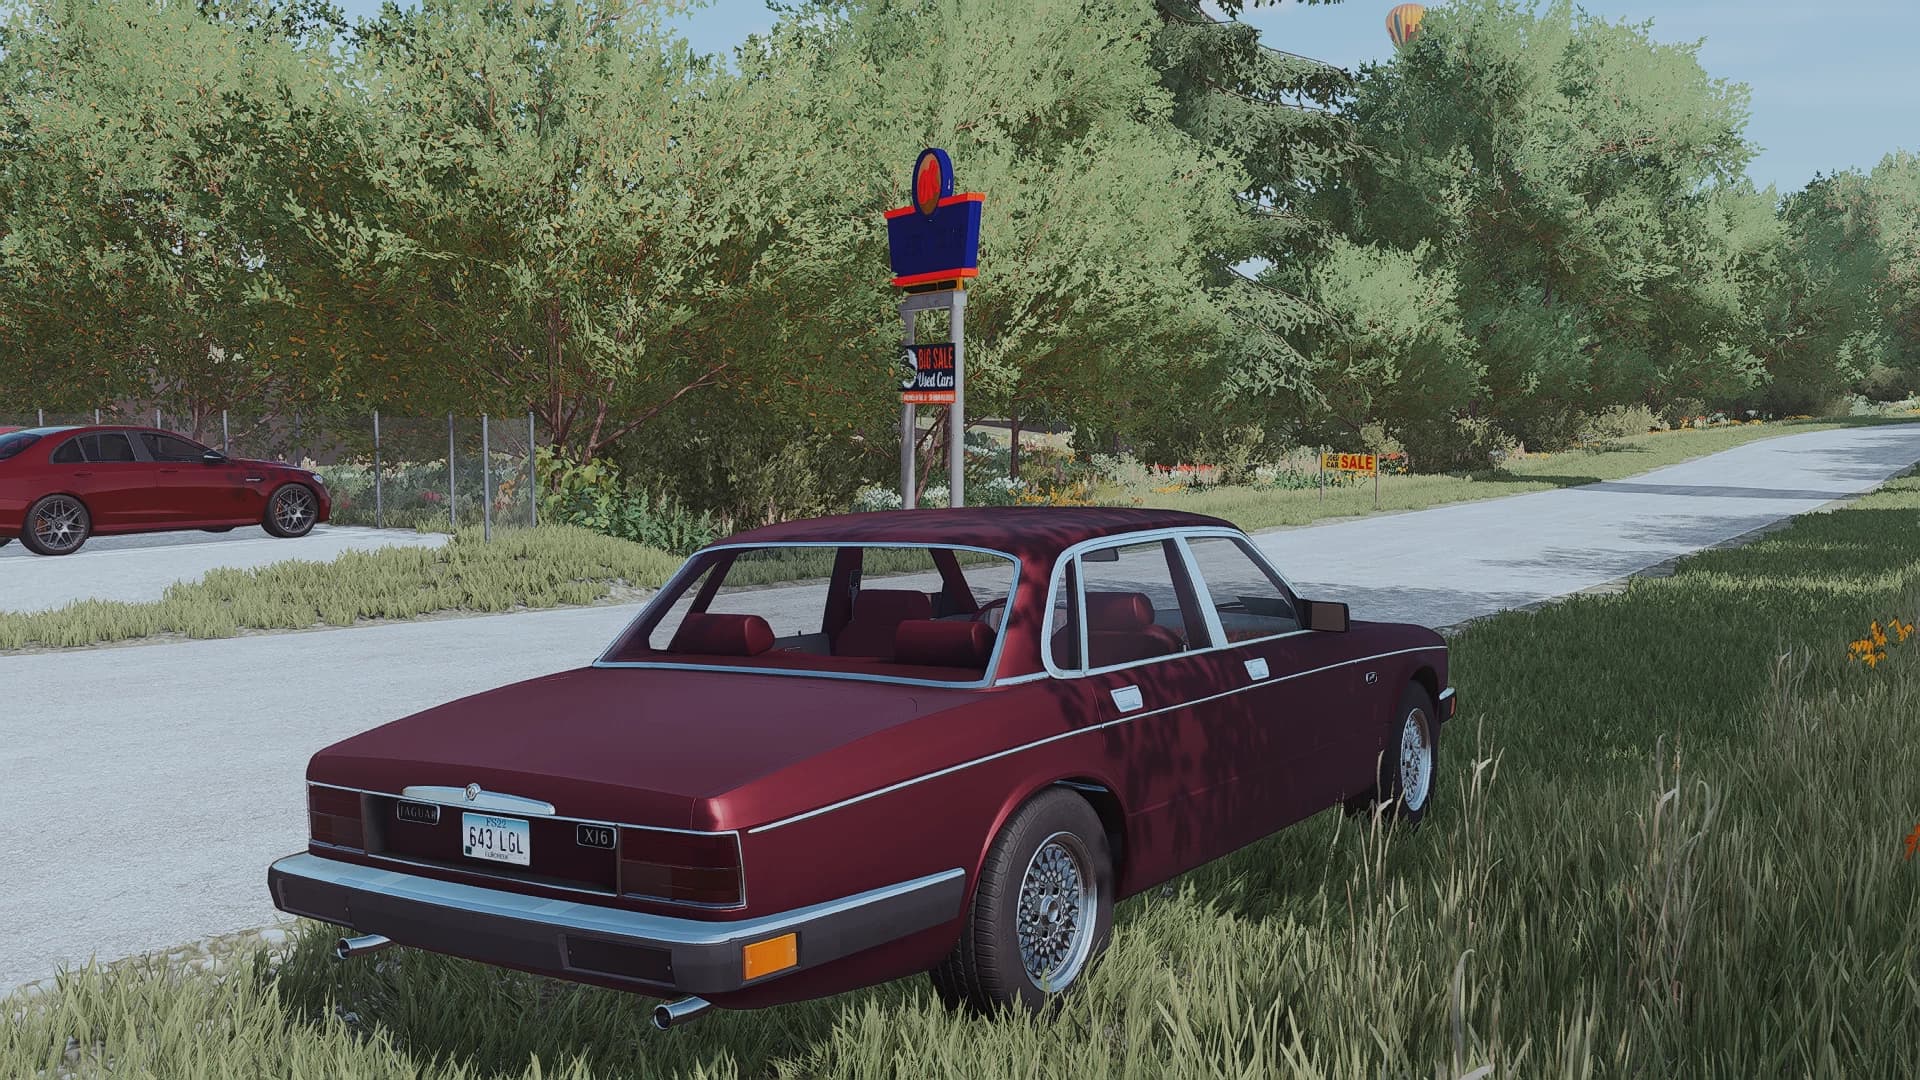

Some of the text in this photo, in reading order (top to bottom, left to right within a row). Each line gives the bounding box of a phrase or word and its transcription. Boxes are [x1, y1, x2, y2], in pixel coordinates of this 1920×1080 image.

[918, 347, 953, 369] BIG SALE
[917, 372, 953, 387] Used Cars
[1326, 461, 1339, 469] CAR
[1341, 455, 1373, 470] SALE
[400, 805, 437, 820] JAGUAR
[486, 817, 507, 829] FS22
[469, 826, 524, 854] 643 LGL
[585, 828, 608, 844] XJ6
